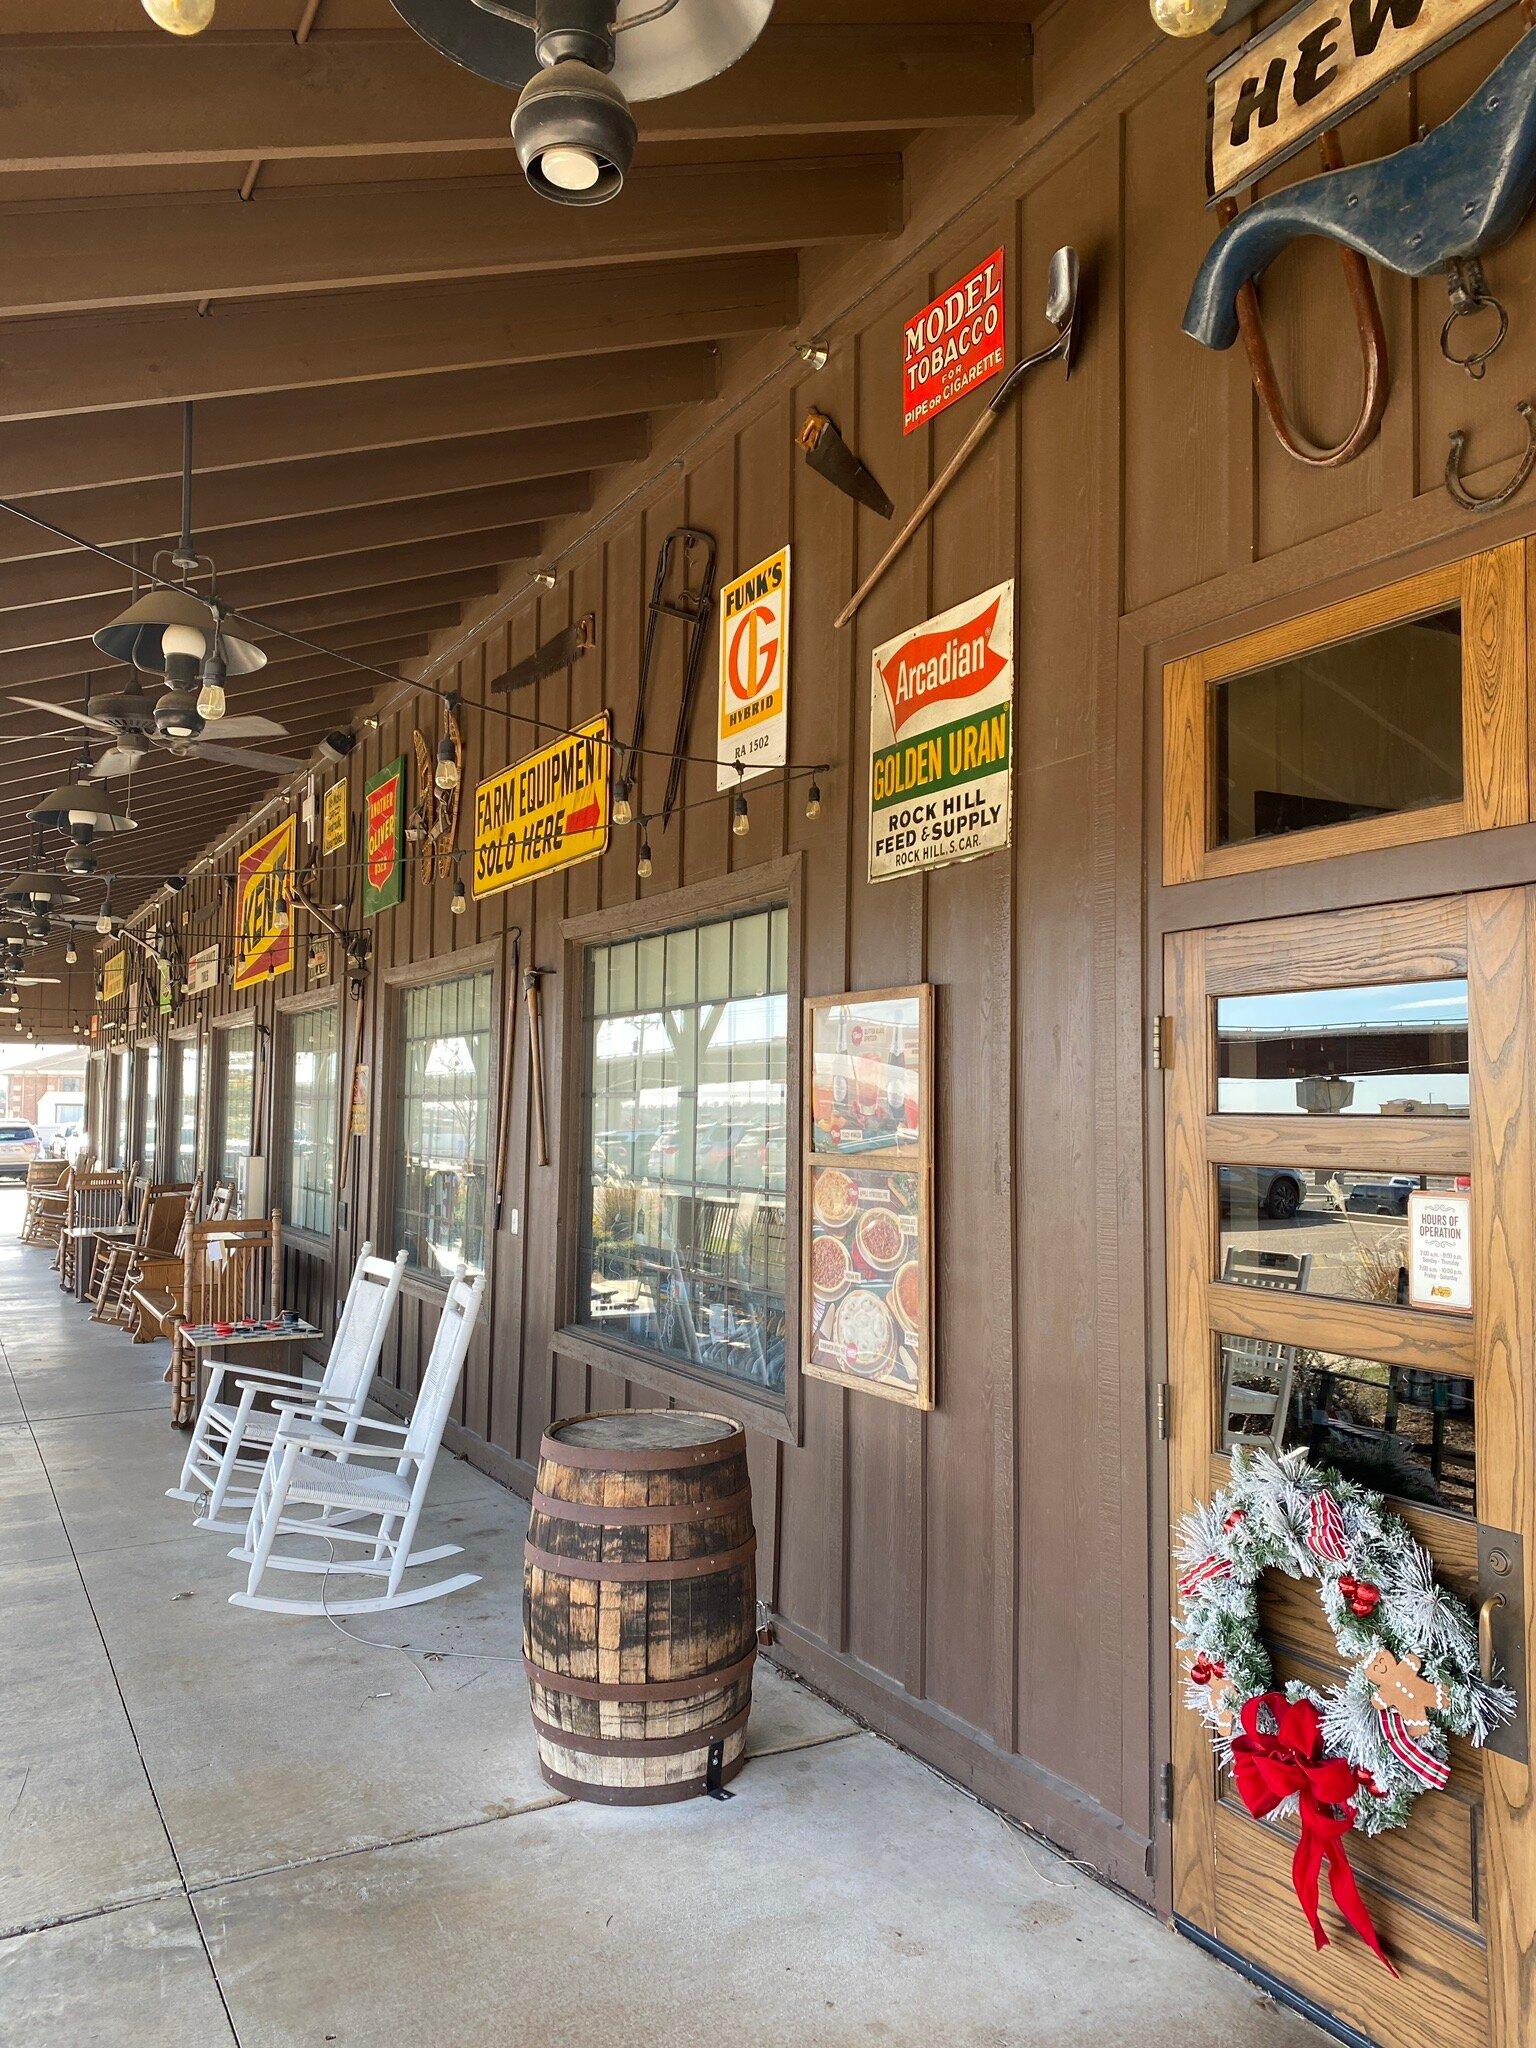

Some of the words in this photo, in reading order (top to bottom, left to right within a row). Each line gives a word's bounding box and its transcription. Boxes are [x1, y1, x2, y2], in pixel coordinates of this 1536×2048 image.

[904, 263, 1001, 363] MODEL
[907, 303, 999, 392] TOBACCO
[941, 364, 962, 383] FOR
[904, 399, 929, 427] PIPE
[943, 346, 1003, 400] CIGARETTE
[725, 561, 782, 617] FUNK'S
[728, 605, 779, 700] G
[895, 634, 985, 706] Arcadian
[729, 694, 774, 727] HYBRID
[734, 743, 746, 759] RA
[749, 734, 769, 755] 1502
[873, 736, 943, 802] GOLDEN
[948, 712, 1006, 777] URAN
[370, 791, 394, 819] ANOTHER
[476, 777, 515, 838] FARM
[519, 729, 605, 817] EQUIPMENT
[368, 813, 395, 856] OLIVER
[875, 829, 917, 857] FEED
[921, 826, 930, 841] &
[932, 804, 1002, 841] SUPPLY
[889, 801, 937, 832] ROCK
[943, 789, 986, 817] HILL
[476, 832, 517, 880] SOLD
[520, 808, 566, 863] HERE
[895, 847, 920, 867] ROCK
[958, 833, 982, 852] CAR.
[1419, 1225, 1461, 1240] OPERATION
[1421, 1213, 1447, 1226] HOURS
[1449, 1215, 1459, 1227] OF
